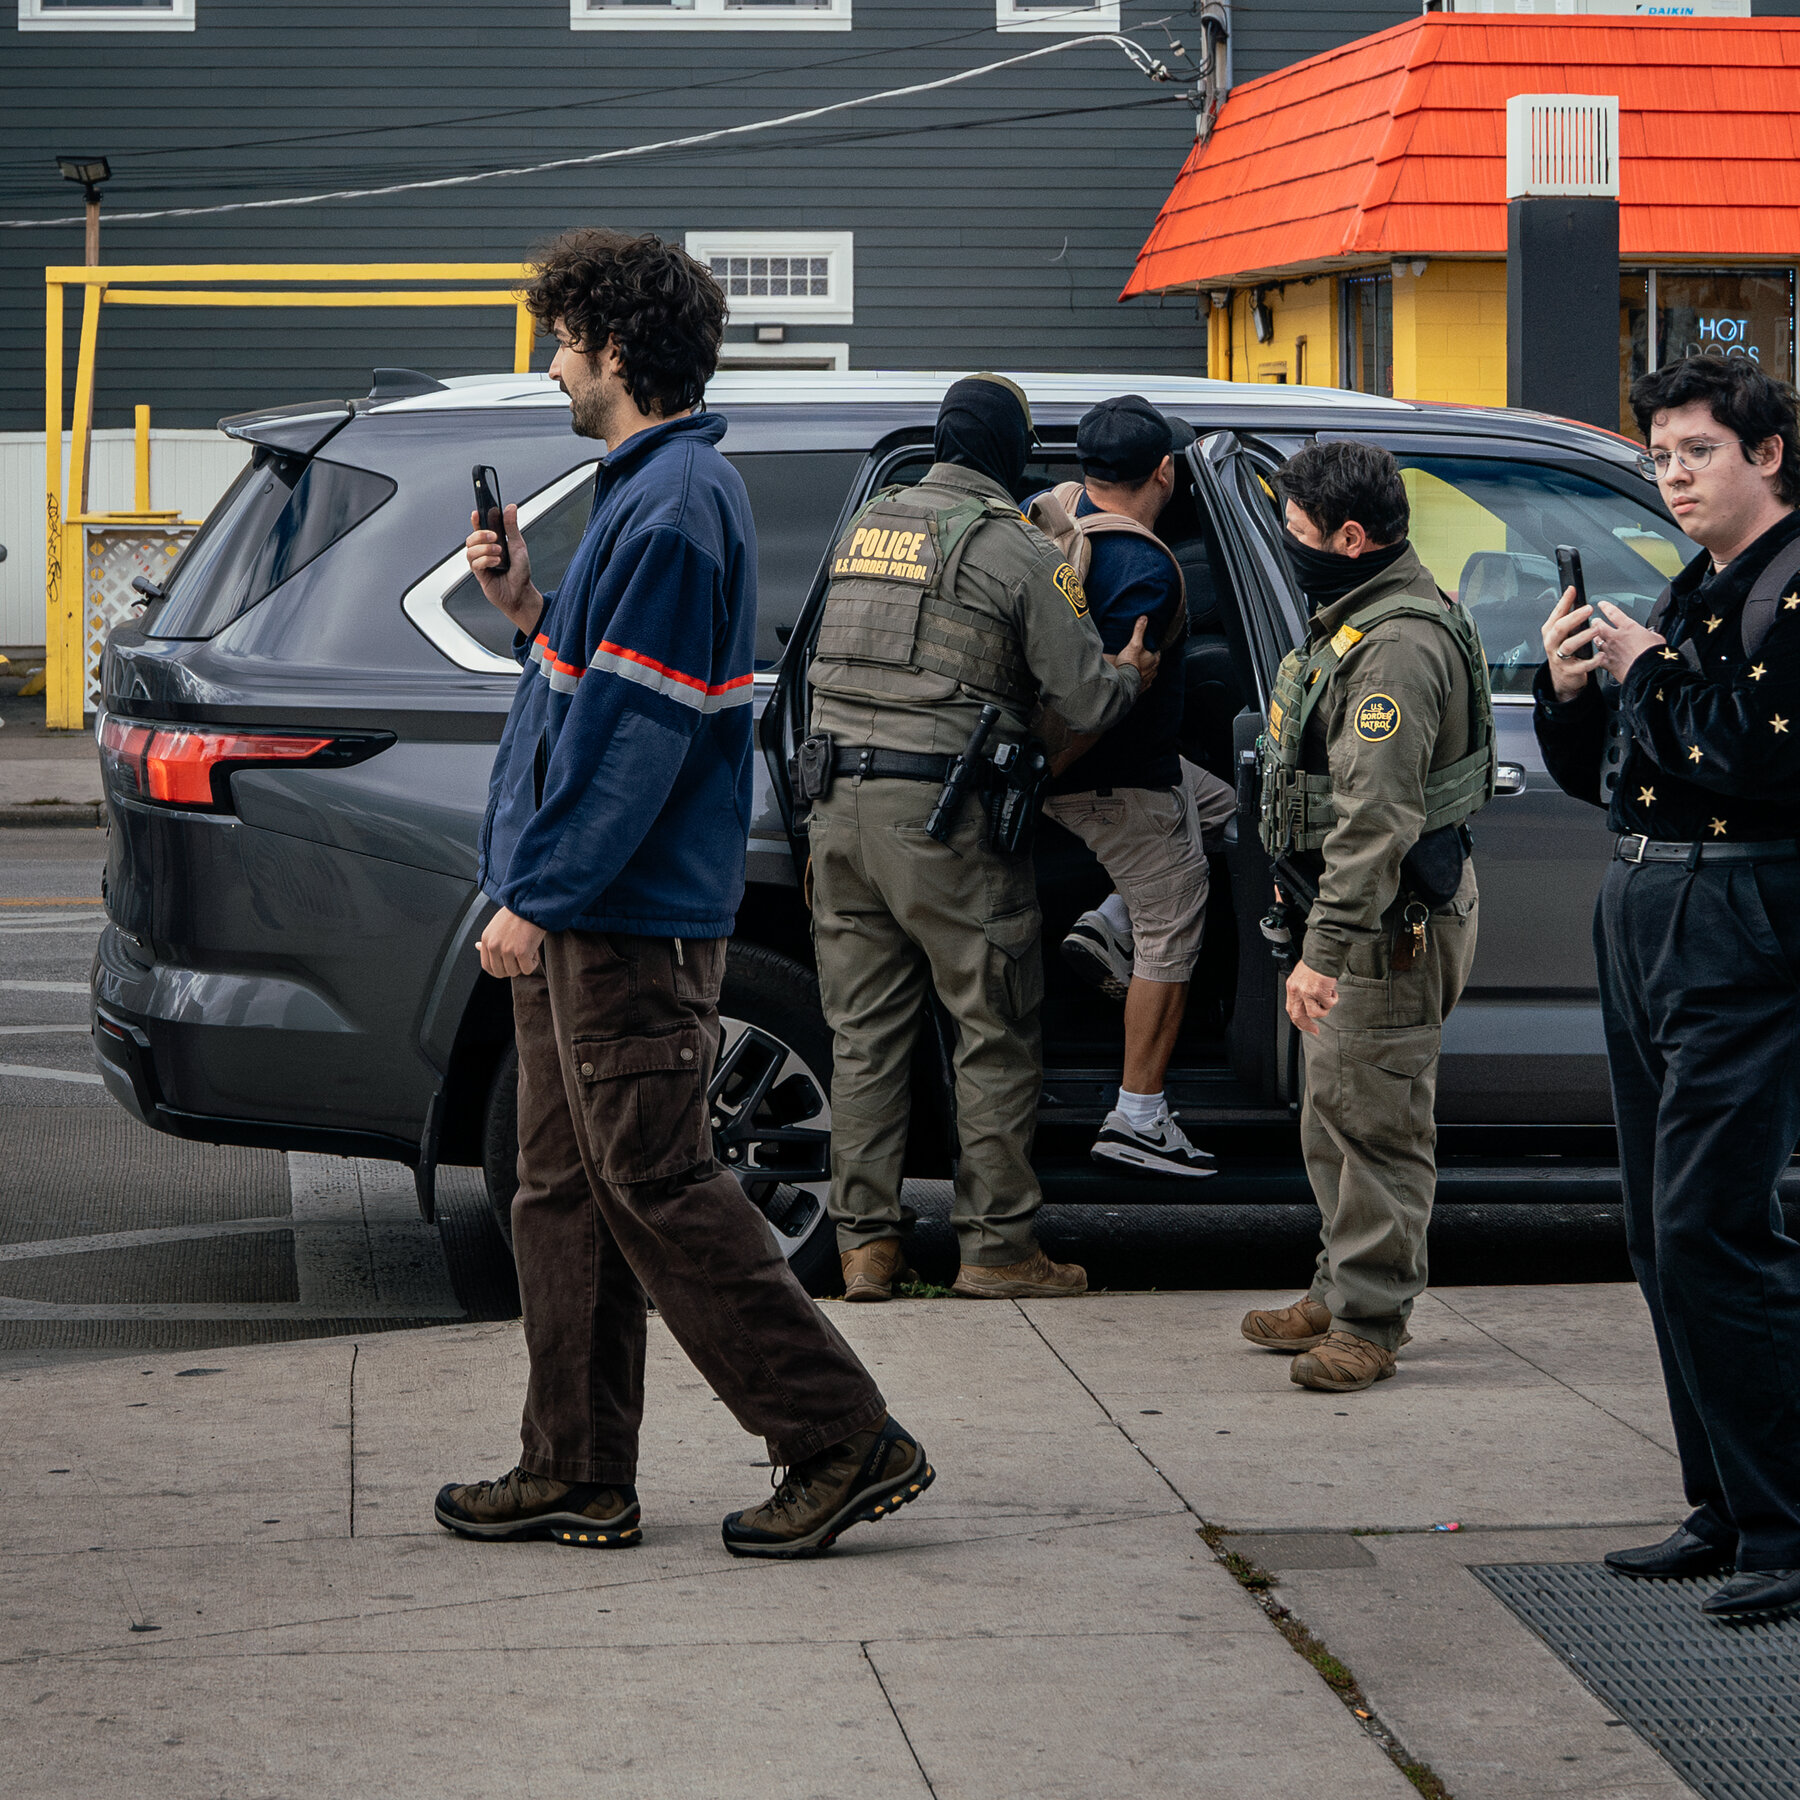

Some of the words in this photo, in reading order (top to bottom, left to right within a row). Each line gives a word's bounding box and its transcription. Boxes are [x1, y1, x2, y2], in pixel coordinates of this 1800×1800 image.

[1649, 7, 1694, 15] DAIKIN
[1699, 317, 1748, 341] HOT
[849, 528, 926, 562] POLICE
[834, 558, 849, 573] U.S.
[849, 558, 888, 574] BORDER
[888, 561, 927, 580] PATROL
[1361, 712, 1392, 720] BORDER
[1360, 720, 1391, 728] PATROL
